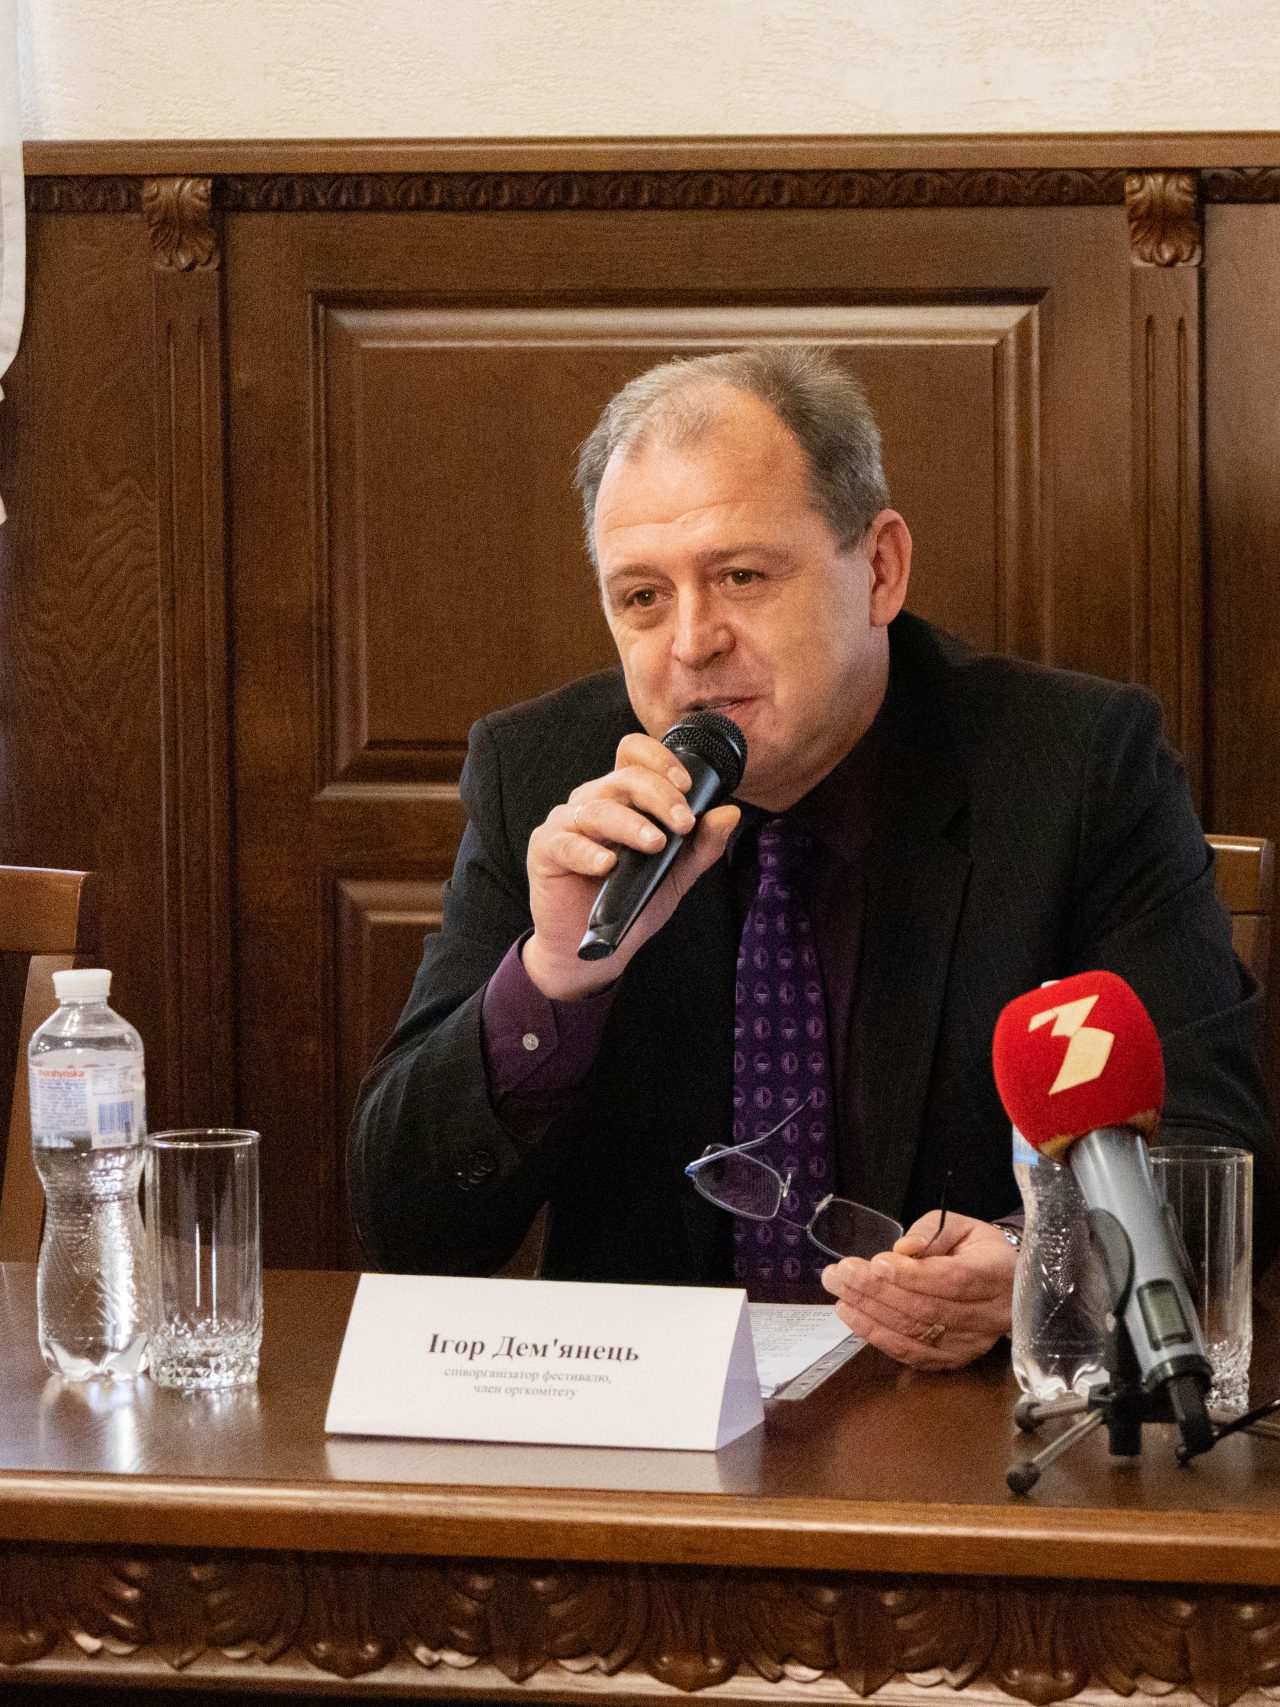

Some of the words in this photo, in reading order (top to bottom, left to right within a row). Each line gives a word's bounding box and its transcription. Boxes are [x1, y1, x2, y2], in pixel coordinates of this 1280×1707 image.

[427, 1333, 486, 1361] Ігор
[492, 1335, 640, 1363] Дем'янець
[444, 1367, 540, 1382] співорганізатор
[542, 1370, 612, 1385] фестивалю,
[472, 1382, 502, 1395] член
[504, 1385, 578, 1400] оргкомітету
